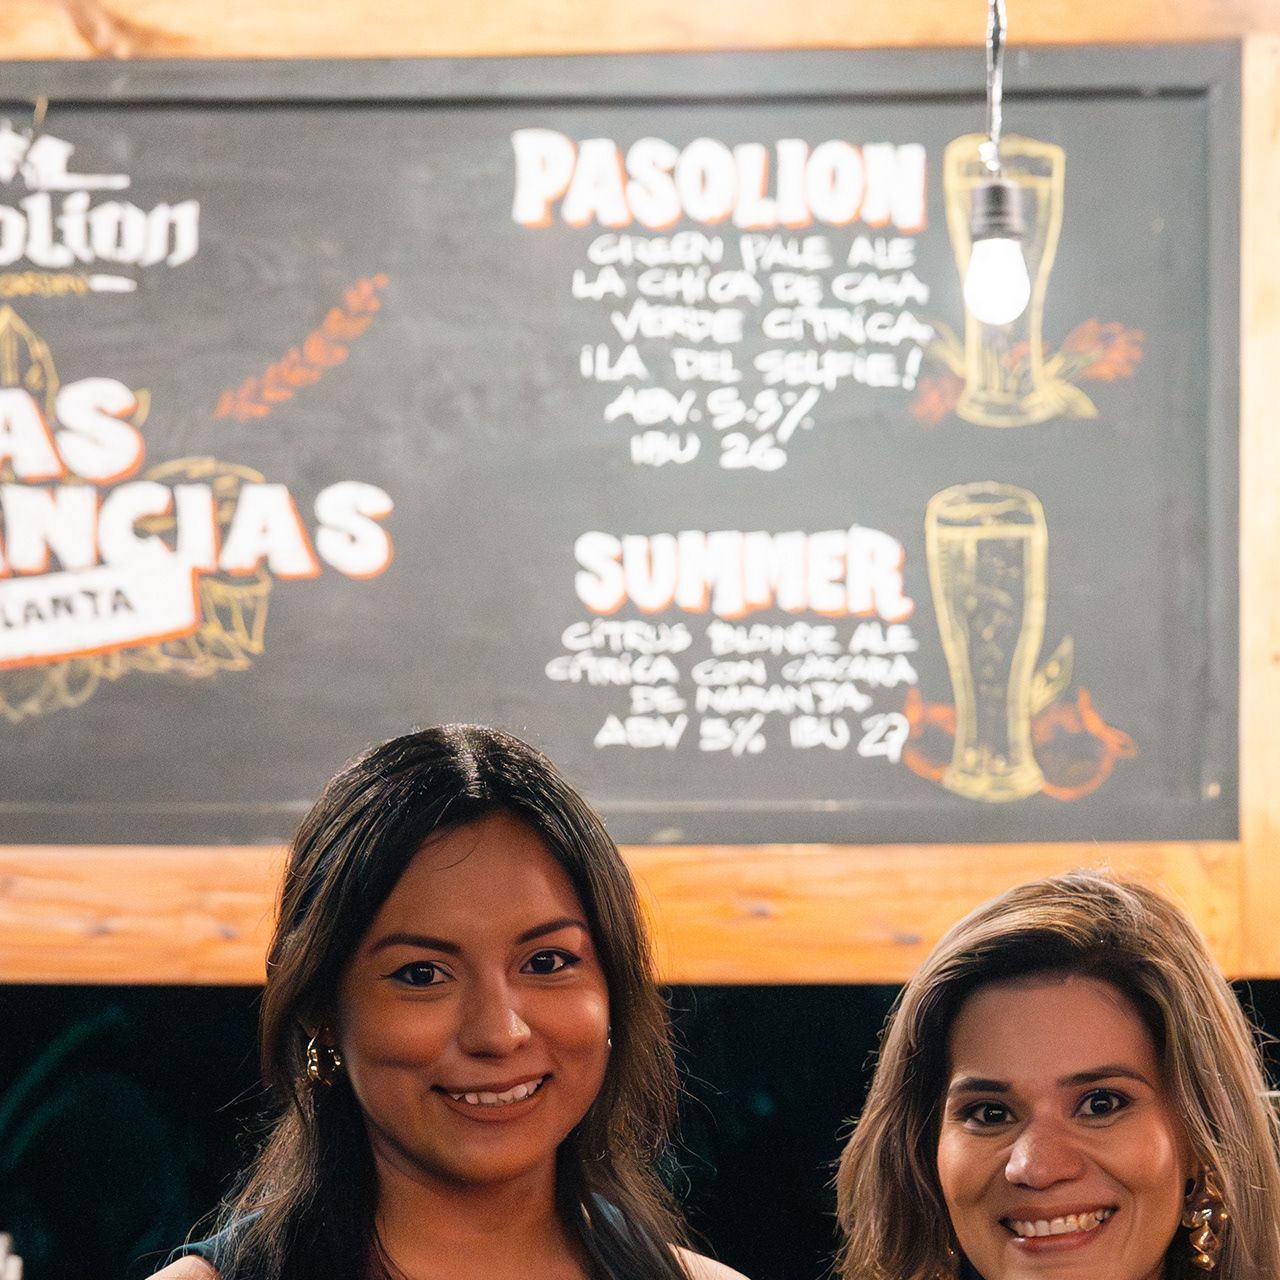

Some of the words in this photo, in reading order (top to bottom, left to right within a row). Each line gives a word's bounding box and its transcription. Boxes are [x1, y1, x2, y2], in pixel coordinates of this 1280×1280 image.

[512, 127, 927, 234] PASOLION
[740, 234, 832, 273] PALE
[848, 234, 917, 269] ALE
[572, 266, 627, 301] LA
[771, 272, 823, 304] DE
[671, 348, 741, 383] DEL
[719, 432, 788, 471] 26
[574, 523, 914, 623] SUMMER
[848, 621, 919, 654] ALE
